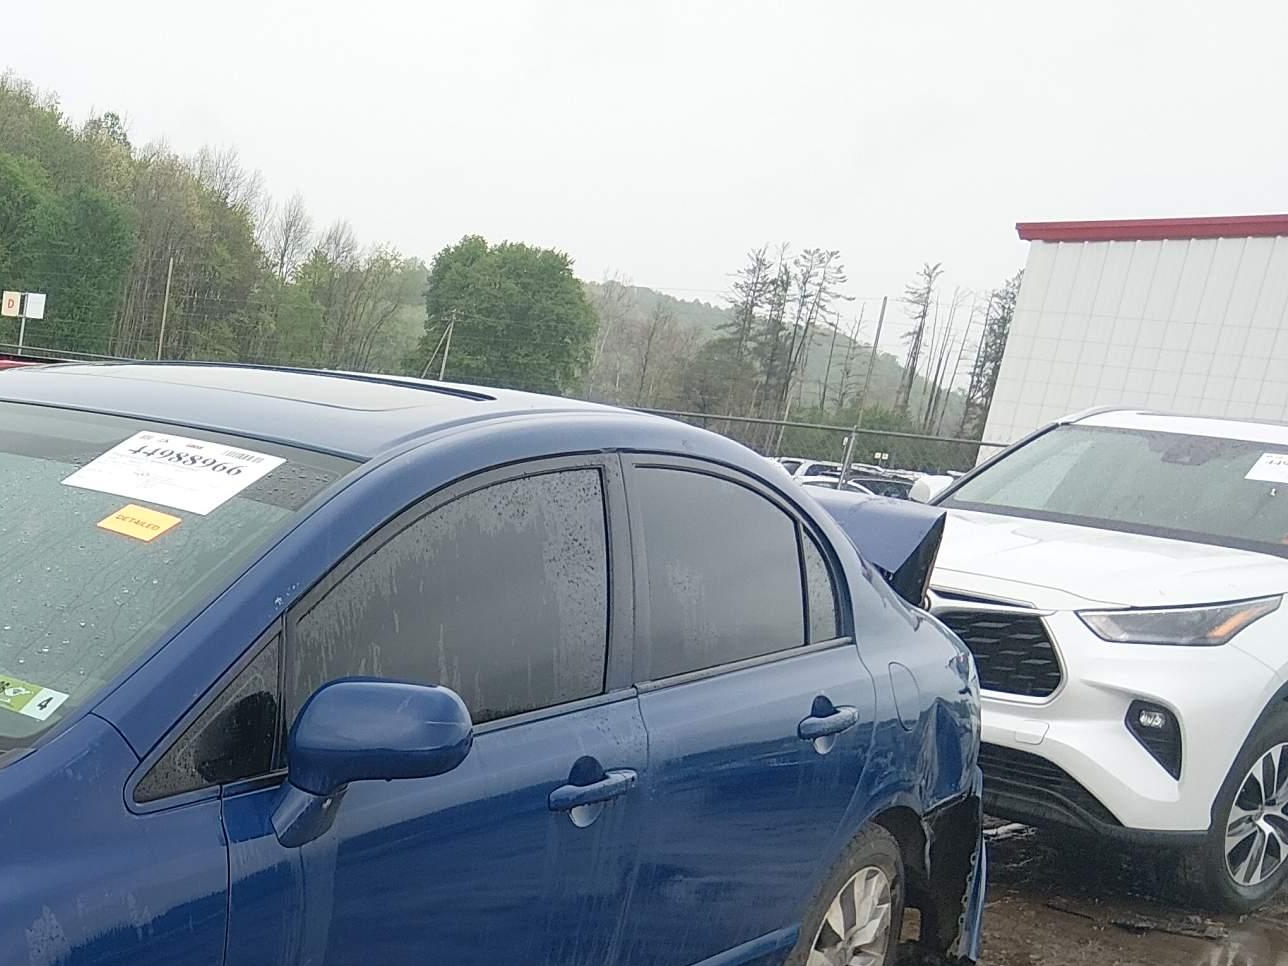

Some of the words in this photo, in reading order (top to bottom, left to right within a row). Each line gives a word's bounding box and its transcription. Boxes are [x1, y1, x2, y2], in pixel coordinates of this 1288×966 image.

[7, 298, 15, 309] D
[128, 444, 247, 477] 44988966
[115, 514, 161, 531] DETAILED
[36, 696, 54, 711] 4
